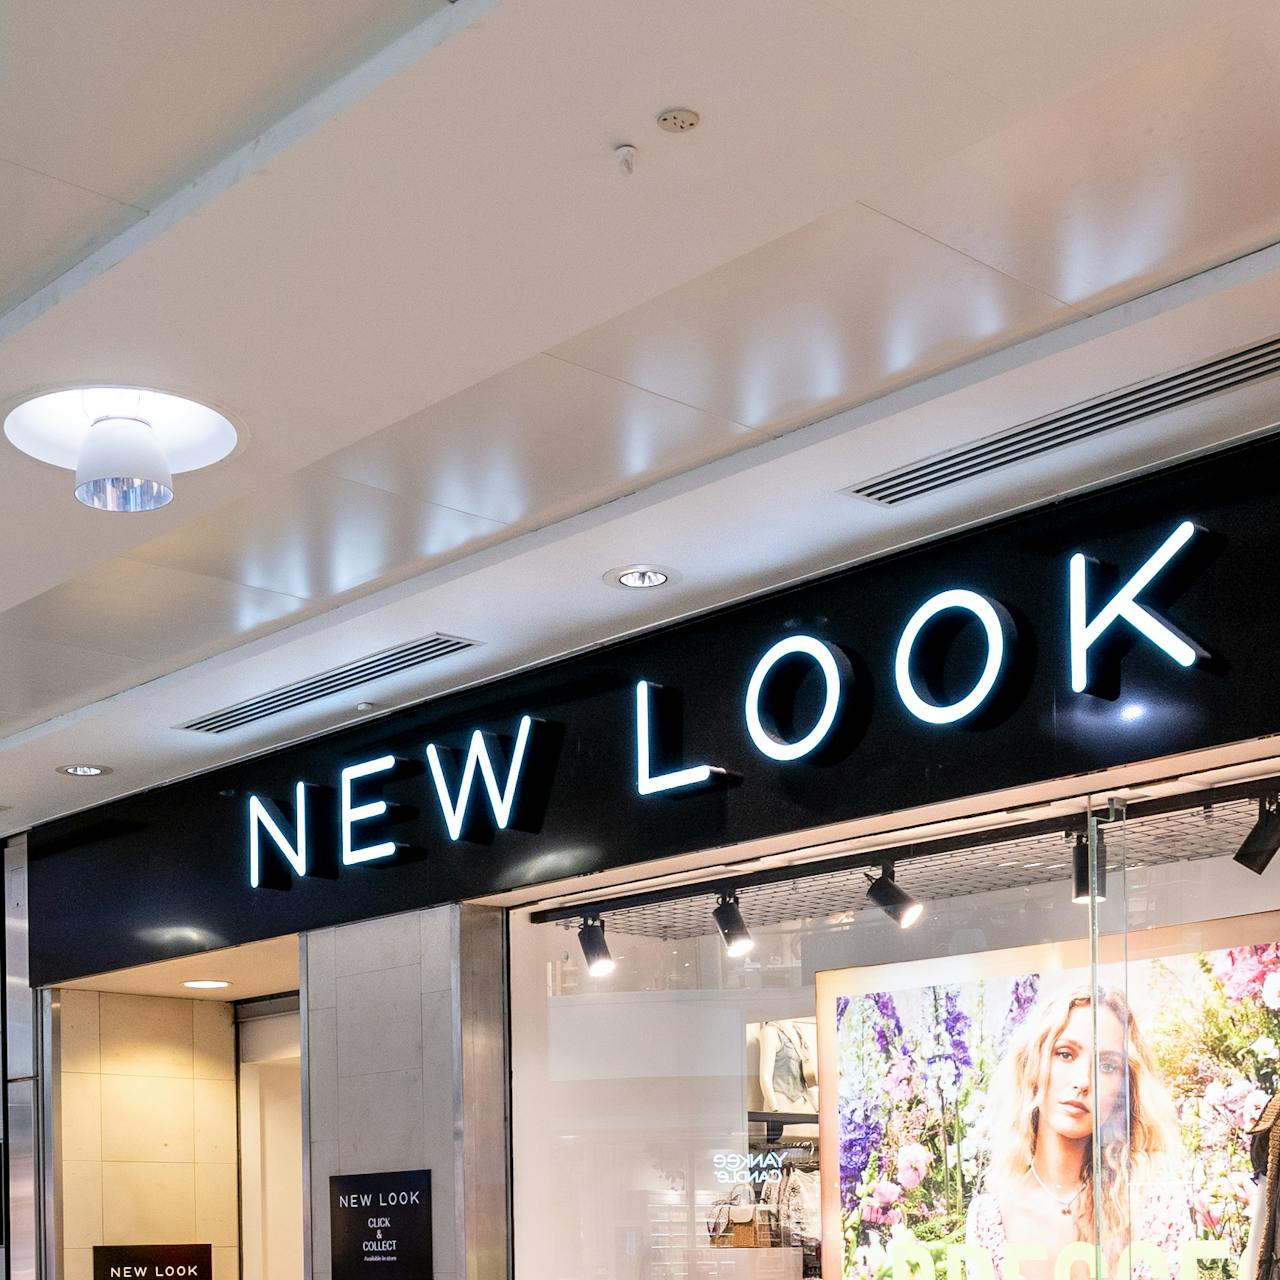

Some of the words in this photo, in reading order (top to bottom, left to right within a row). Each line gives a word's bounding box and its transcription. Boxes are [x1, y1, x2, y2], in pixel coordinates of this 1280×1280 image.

[248, 715, 532, 889] NEW
[635, 520, 1199, 797] LOOK
[339, 1194, 372, 1208] NEW
[379, 1191, 420, 1206] LOOK
[367, 1217, 391, 1228] CLICK
[376, 1229, 382, 1239] &
[362, 1240, 397, 1251] COLLECT
[110, 1266, 148, 1278] NEW
[155, 1265, 198, 1277] LOOK
